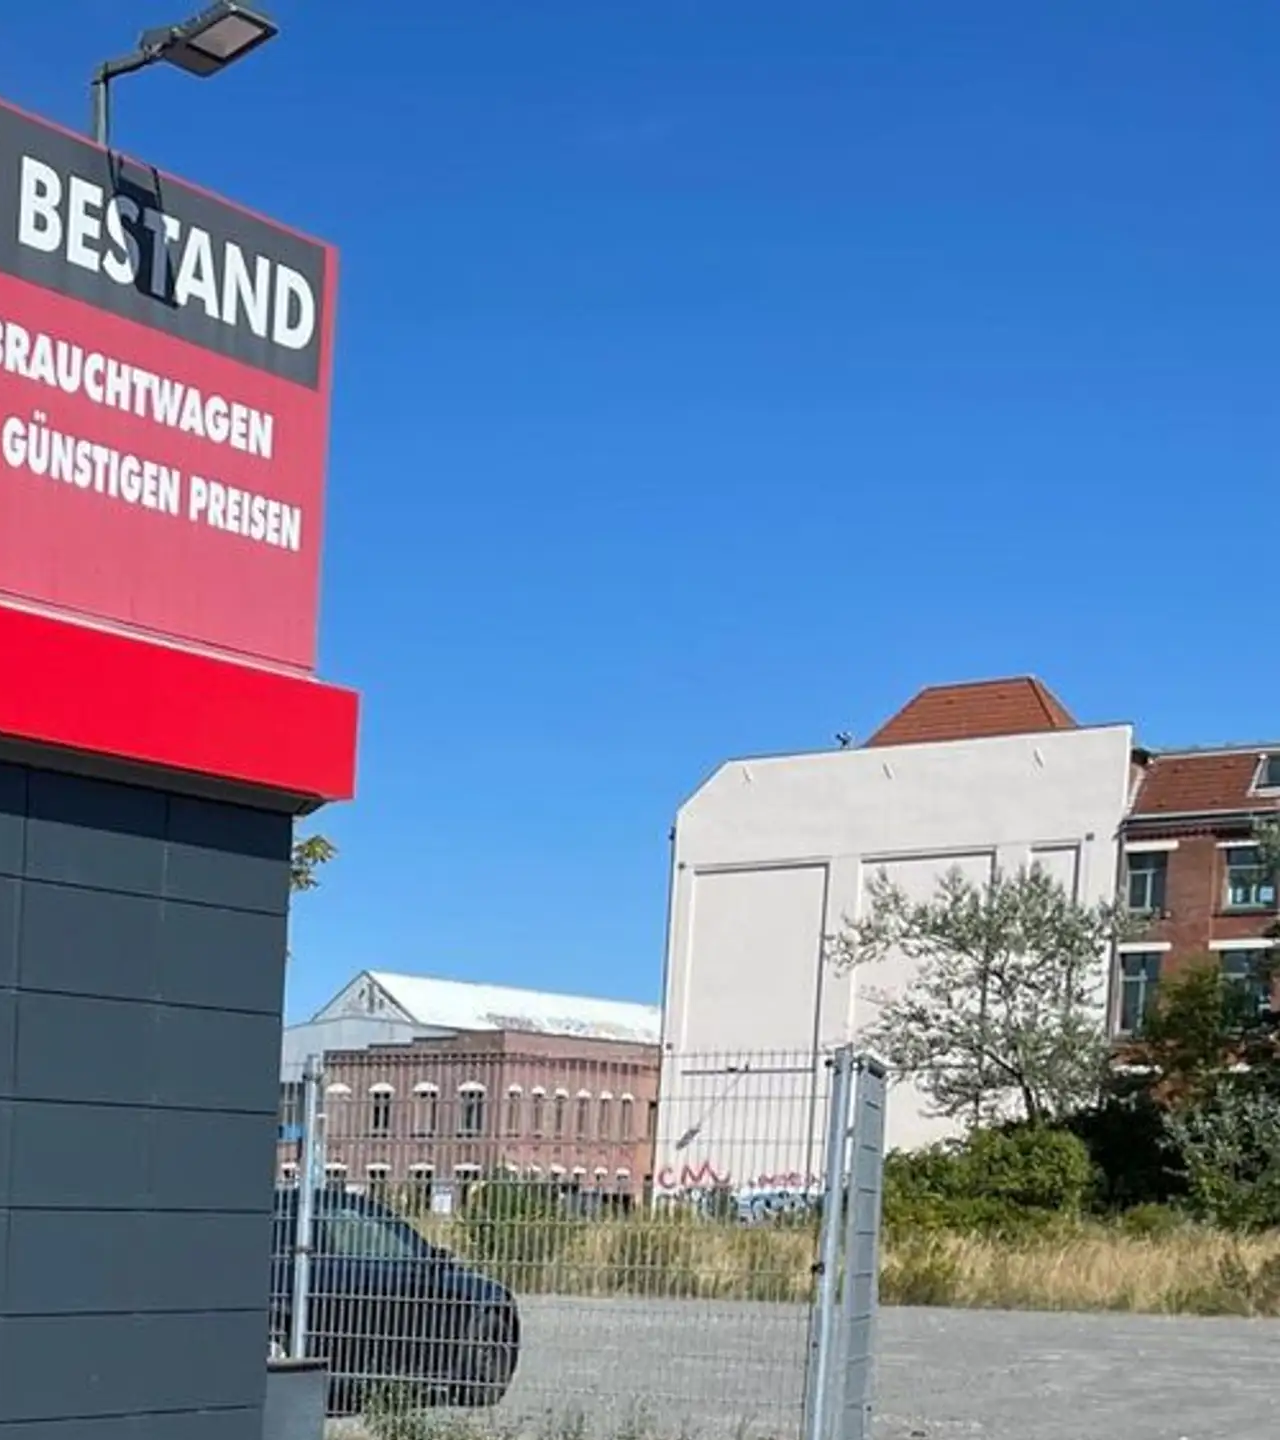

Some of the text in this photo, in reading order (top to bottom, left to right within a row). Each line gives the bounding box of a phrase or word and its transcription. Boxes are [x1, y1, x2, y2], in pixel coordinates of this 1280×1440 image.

[18, 155, 315, 350] BESTAND
[1, 409, 180, 518] GÜNSTIGEN
[188, 476, 302, 552] PREISEN
